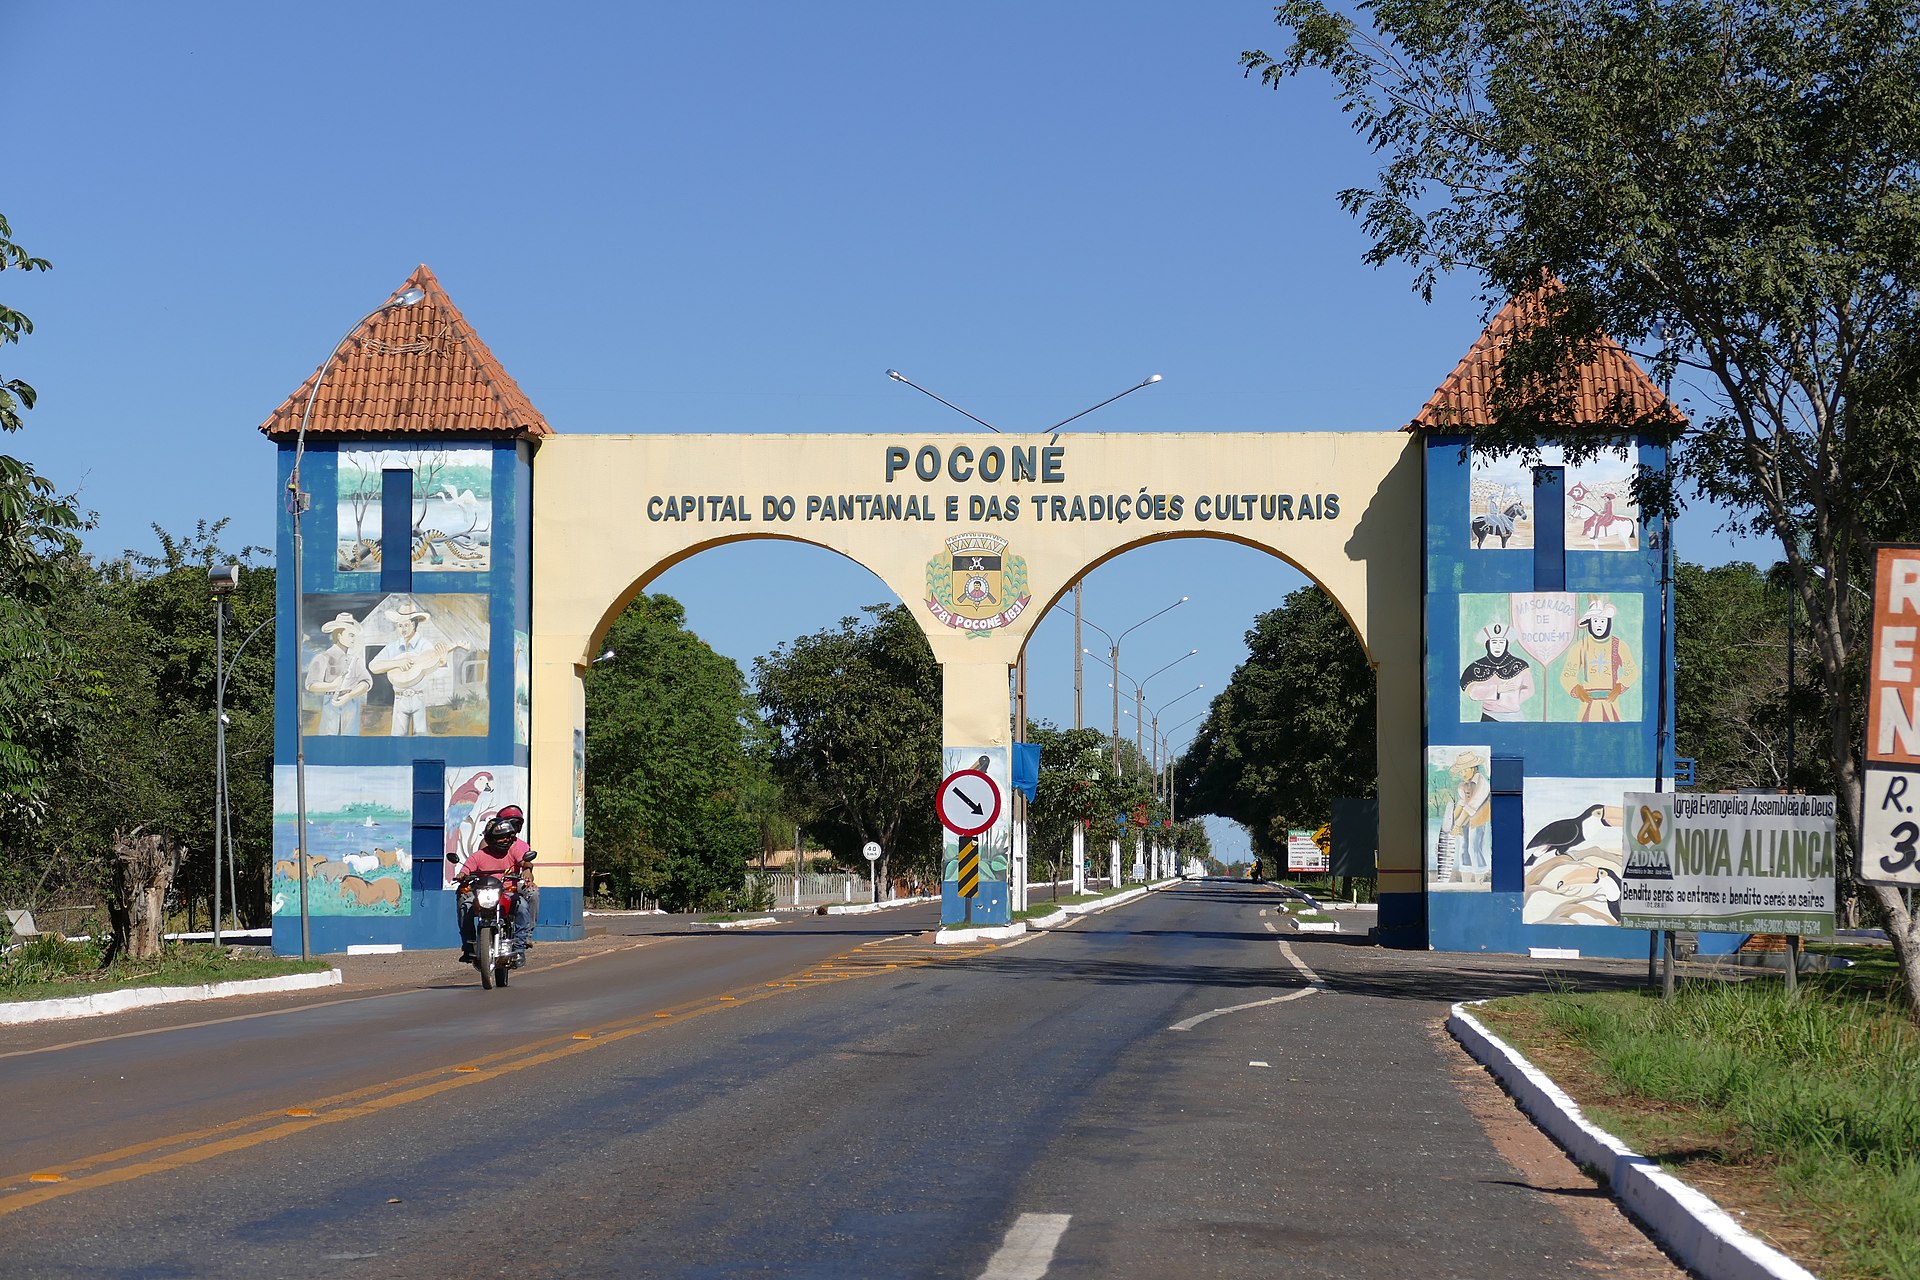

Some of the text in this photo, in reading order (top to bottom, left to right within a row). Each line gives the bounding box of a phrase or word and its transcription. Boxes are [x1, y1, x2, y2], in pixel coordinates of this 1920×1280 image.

[885, 433, 1065, 483] POCONÉ
[647, 495, 751, 522] CAPITAL
[763, 495, 795, 522] DO
[806, 495, 935, 522] PANTANAL
[946, 495, 958, 522] E
[969, 494, 1020, 522] DAS
[1194, 493, 1341, 521] CULTURAIS
[930, 602, 951, 625] 1781
[1004, 600, 1024, 621] 1831
[1516, 598, 1575, 617] MASCARADOS
[1536, 614, 1550, 624] DE
[1673, 794, 1698, 819] Igreja
[1800, 796, 1810, 816] de
[1811, 797, 1834, 817] Deus
[1628, 850, 1668, 868] ADNA
[1674, 828, 1732, 877] NOVA
[1623, 881, 1651, 901] Bendito
[1653, 886, 1674, 903] serás
[1676, 890, 1686, 903] ao
[1687, 885, 1720, 904] entrares
[1722, 892, 1727, 904] e
[1729, 887, 1761, 906] bendito
[1763, 891, 1786, 907] serás
[1788, 894, 1797, 907] ao
